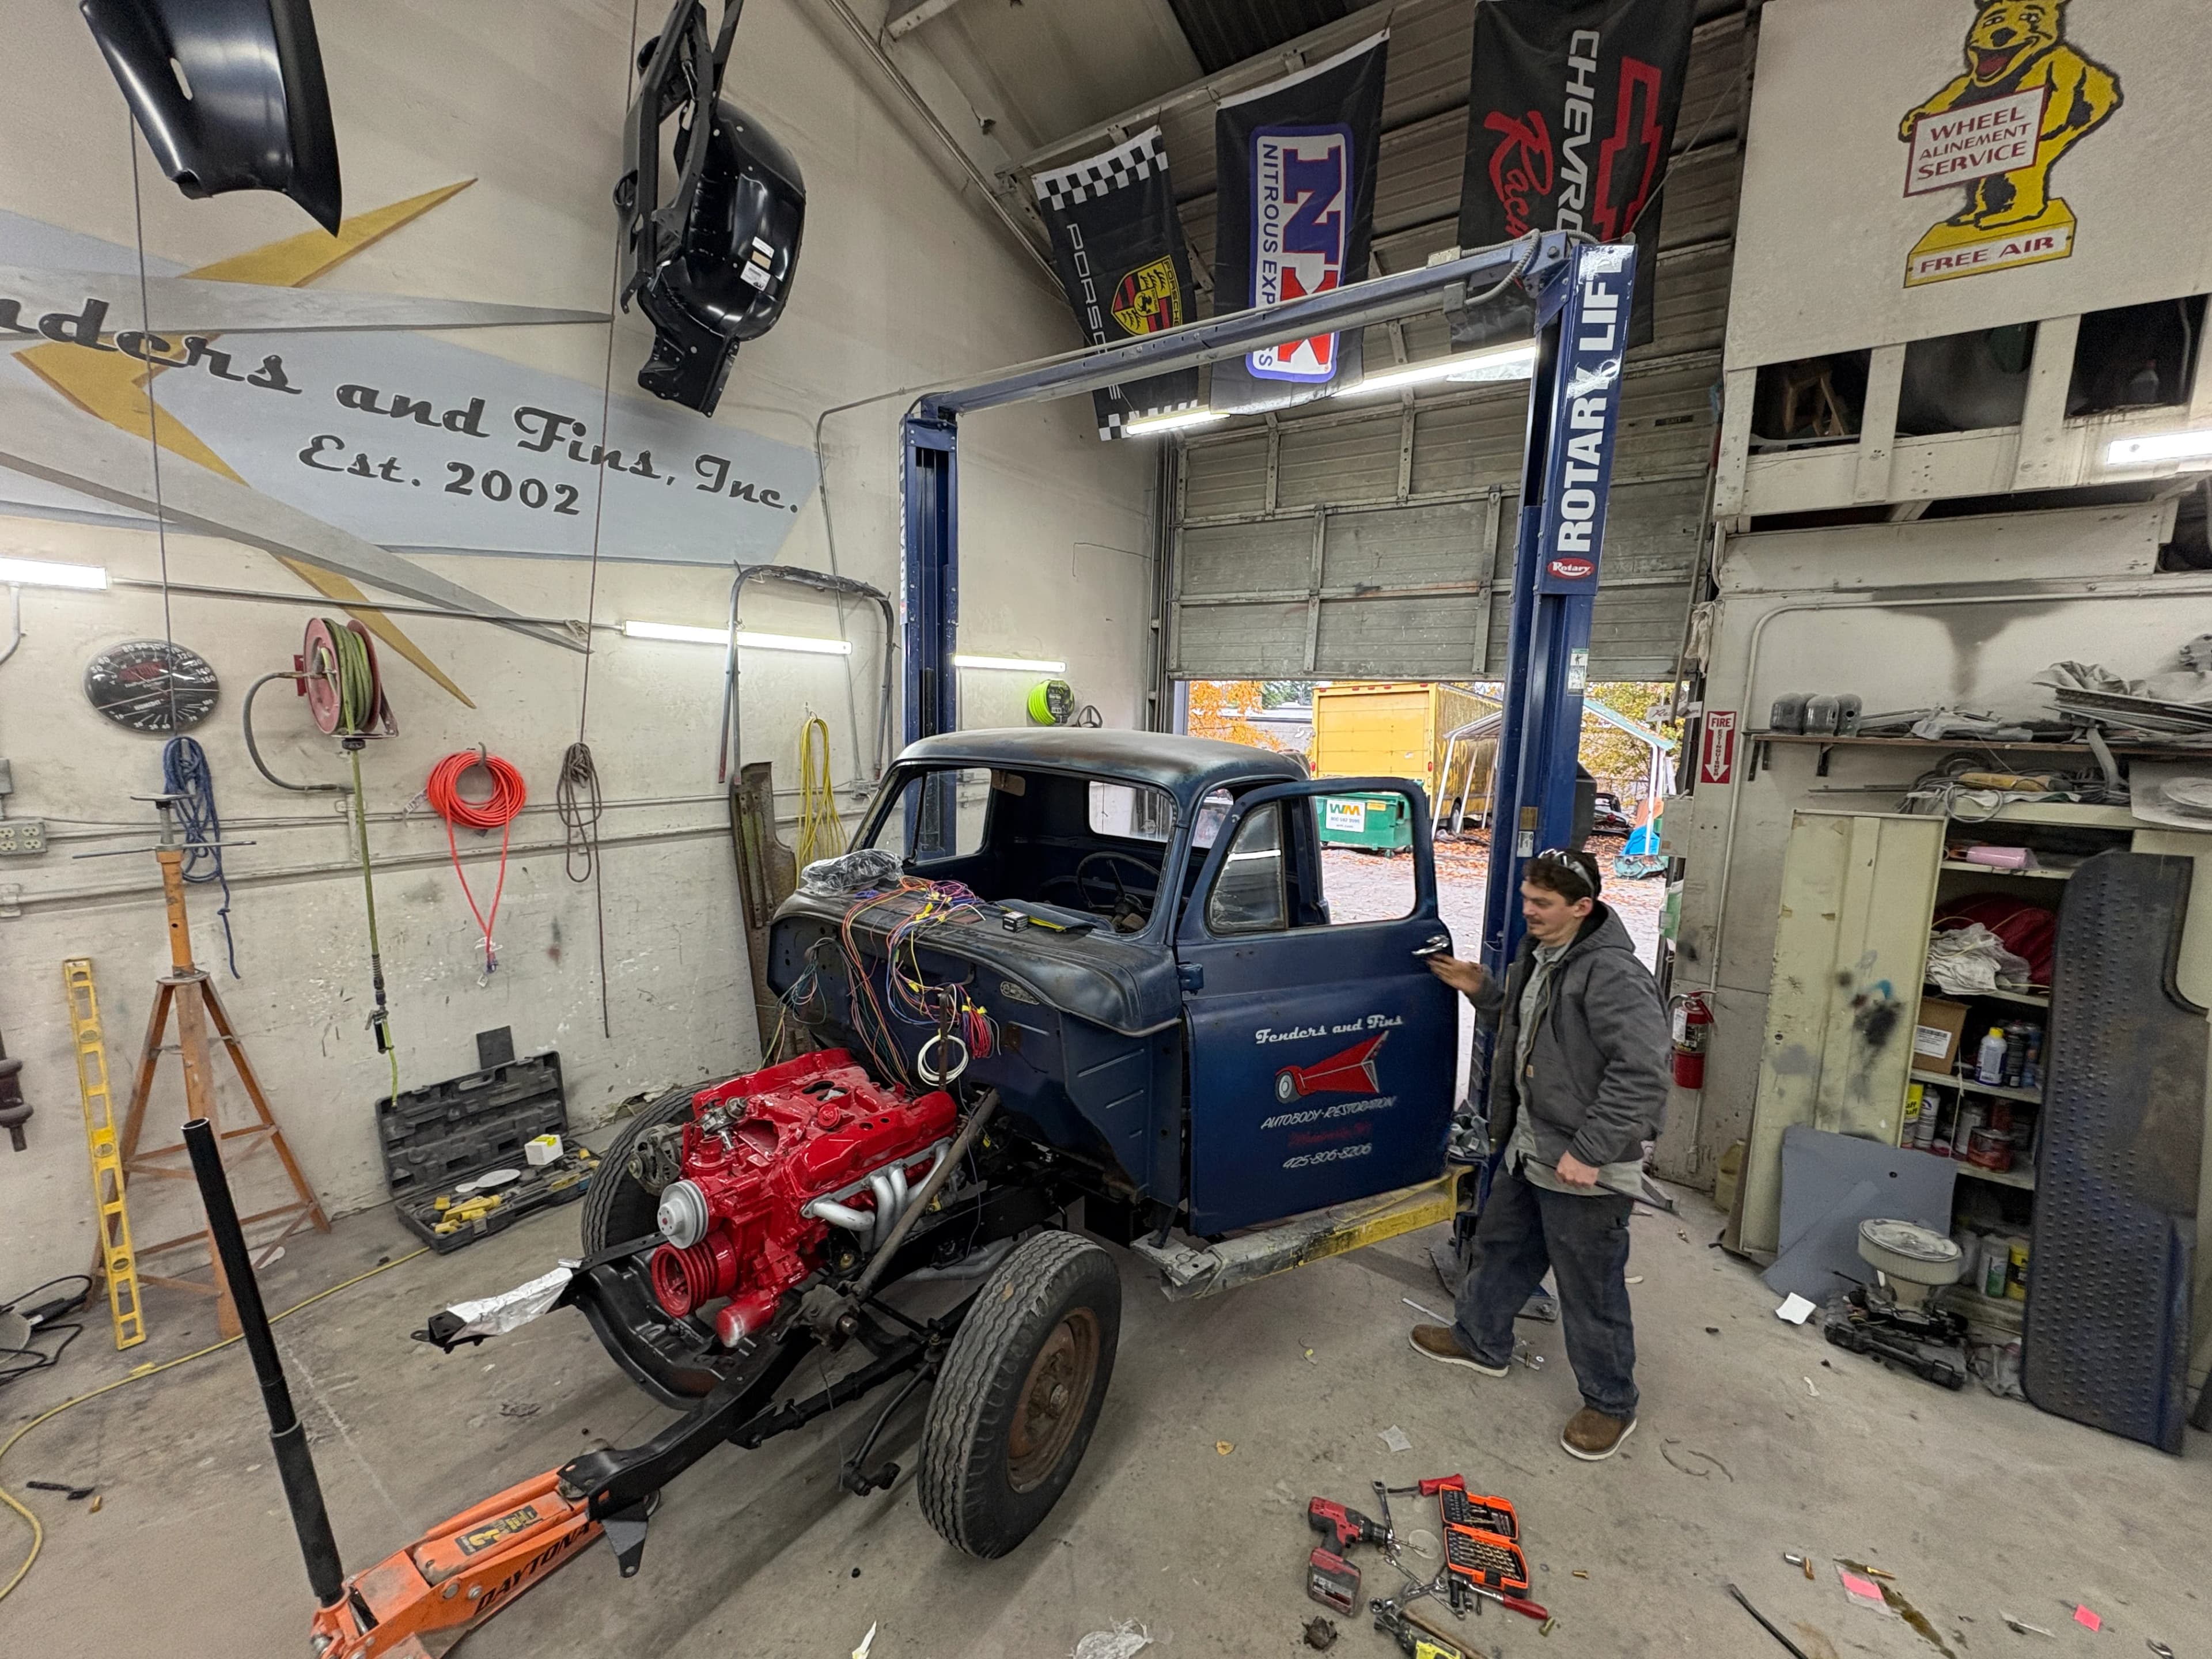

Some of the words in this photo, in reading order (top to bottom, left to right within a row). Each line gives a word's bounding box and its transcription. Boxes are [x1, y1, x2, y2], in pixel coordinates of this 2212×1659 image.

[1919, 123, 2032, 161] ALINEMENT
[1930, 106, 2026, 142] WHEEL
[1917, 141, 2027, 180] SERVICE
[1262, 143, 1279, 253] NITROUS
[1921, 249, 1988, 273] FREE
[1999, 236, 2054, 259] AIR
[336, 384, 490, 438] and
[514, 406, 675, 486] Fins,
[695, 454, 798, 513] Inc.
[1557, 362, 1612, 552] ROTARY
[298, 435, 421, 486] Est.
[444, 461, 580, 516] 2002
[1552, 561, 1590, 577] Rotary
[200, 675, 216, 684] 150
[1711, 718, 1732, 727] FIRE
[1330, 804, 1361, 816] WM
[1255, 1025, 1327, 1044] Fenders
[1332, 1018, 1363, 1033] and
[1366, 1014, 1403, 1029] Fins
[475, 1522, 590, 1613] DAYTONA
